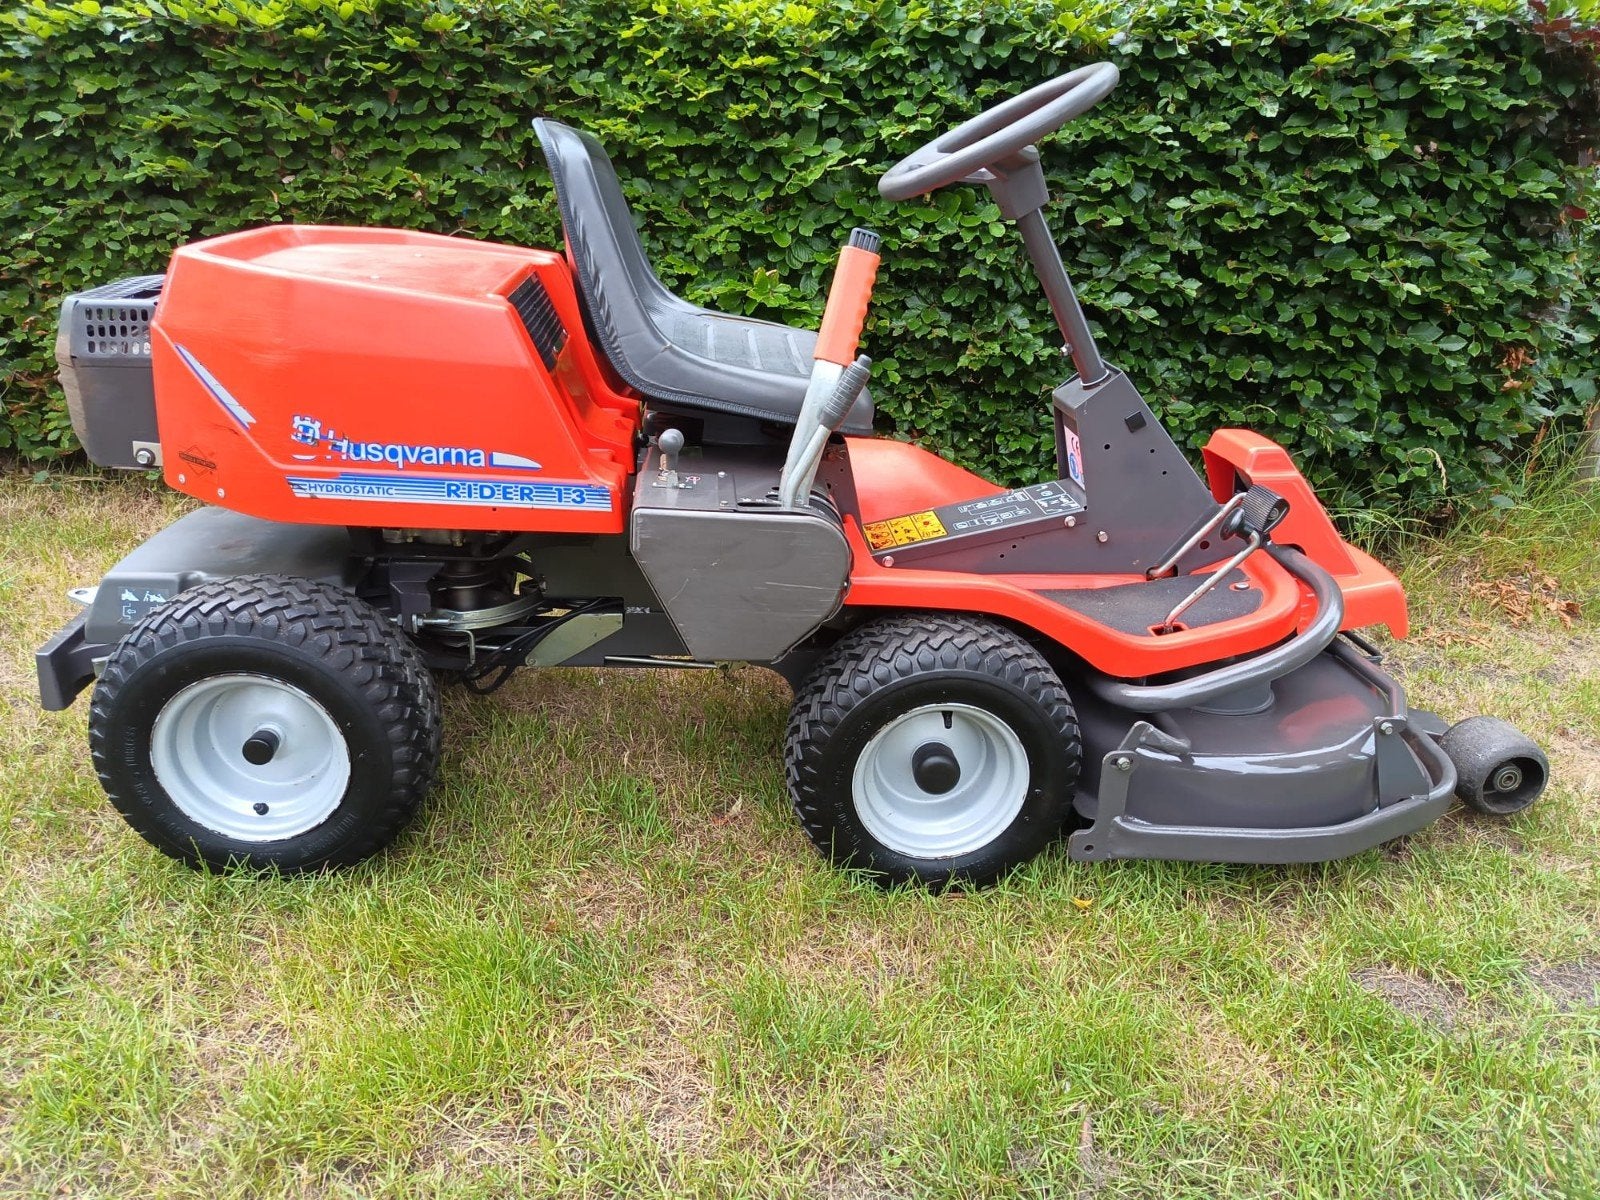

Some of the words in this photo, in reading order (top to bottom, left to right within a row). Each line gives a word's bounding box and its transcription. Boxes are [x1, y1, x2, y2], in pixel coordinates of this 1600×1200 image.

[326, 429, 485, 468] Husqvarna
[308, 482, 395, 496] HYDROSTATIC
[446, 483, 534, 502] RIDER
[555, 487, 587, 504] 13
